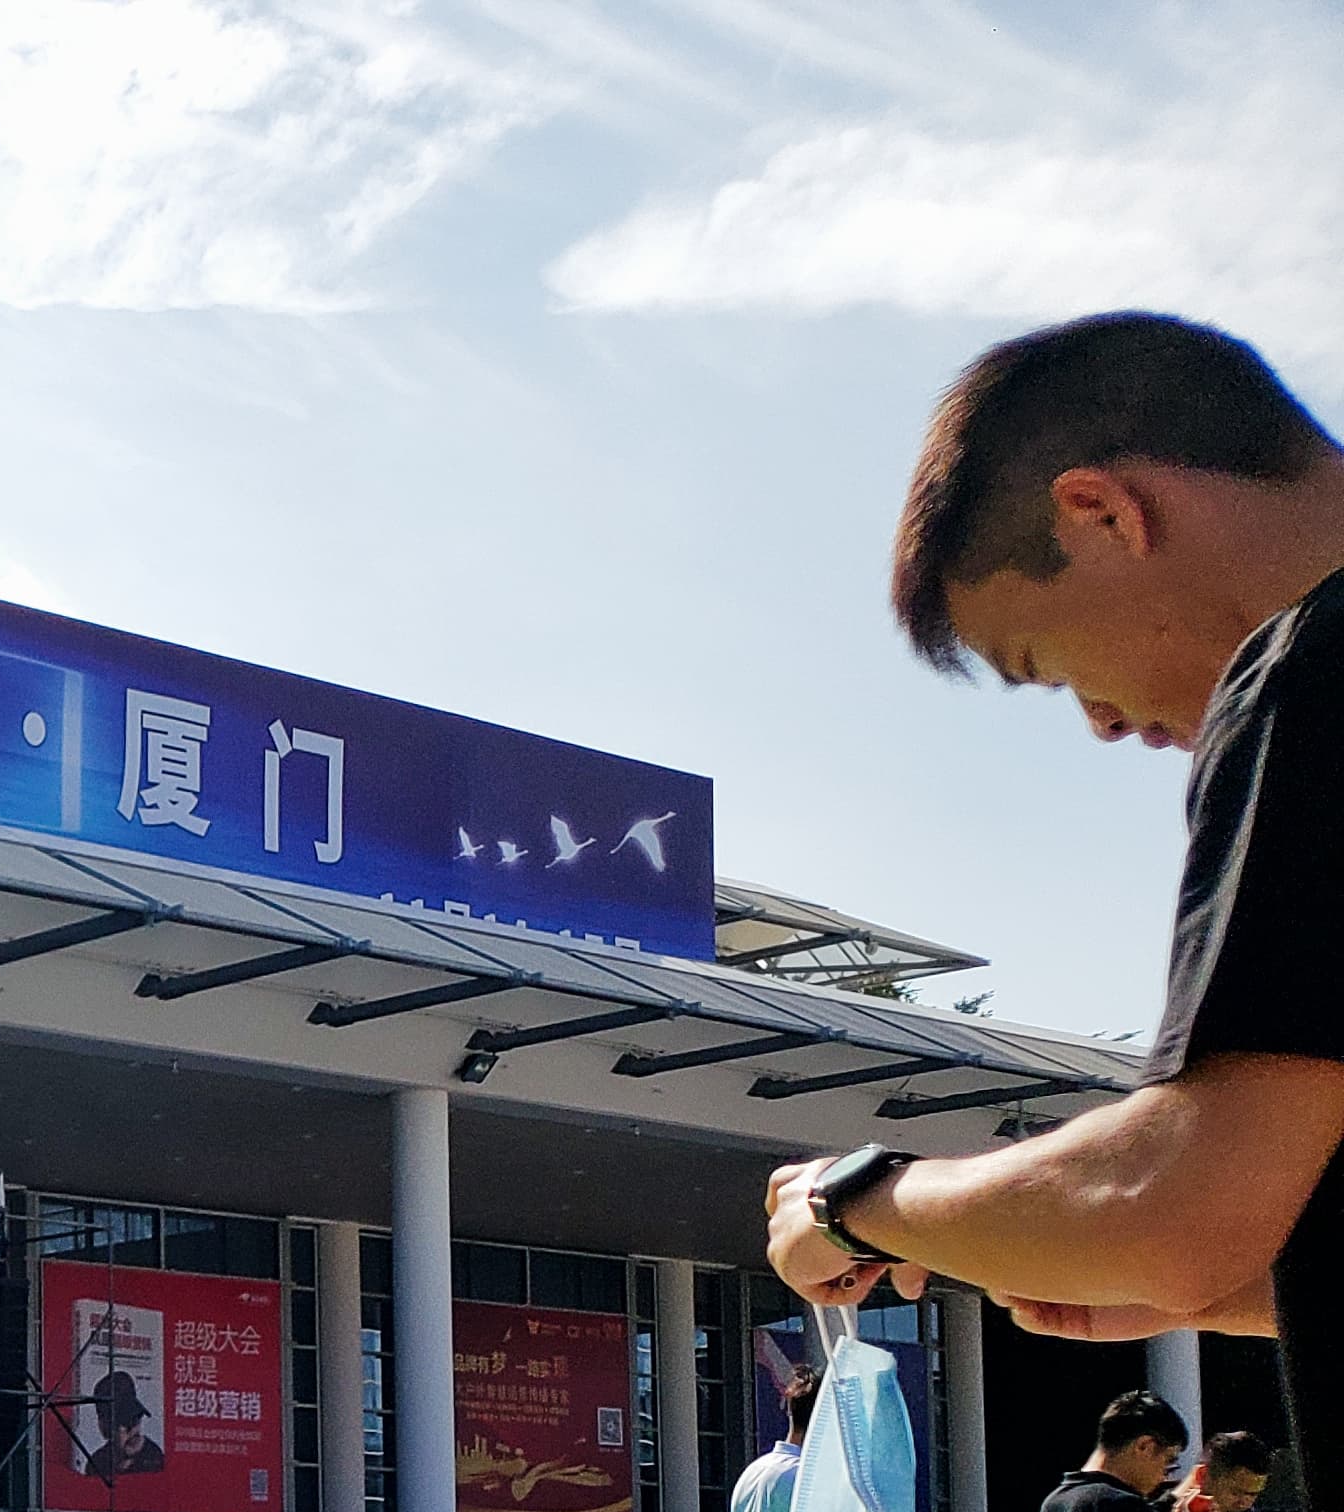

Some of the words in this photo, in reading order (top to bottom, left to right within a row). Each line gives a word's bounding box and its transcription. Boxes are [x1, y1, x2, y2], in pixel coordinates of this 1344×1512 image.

[174, 1319, 262, 1356] 超级大会
[174, 1355, 219, 1386] 就是
[174, 1388, 262, 1422] 超级营销
